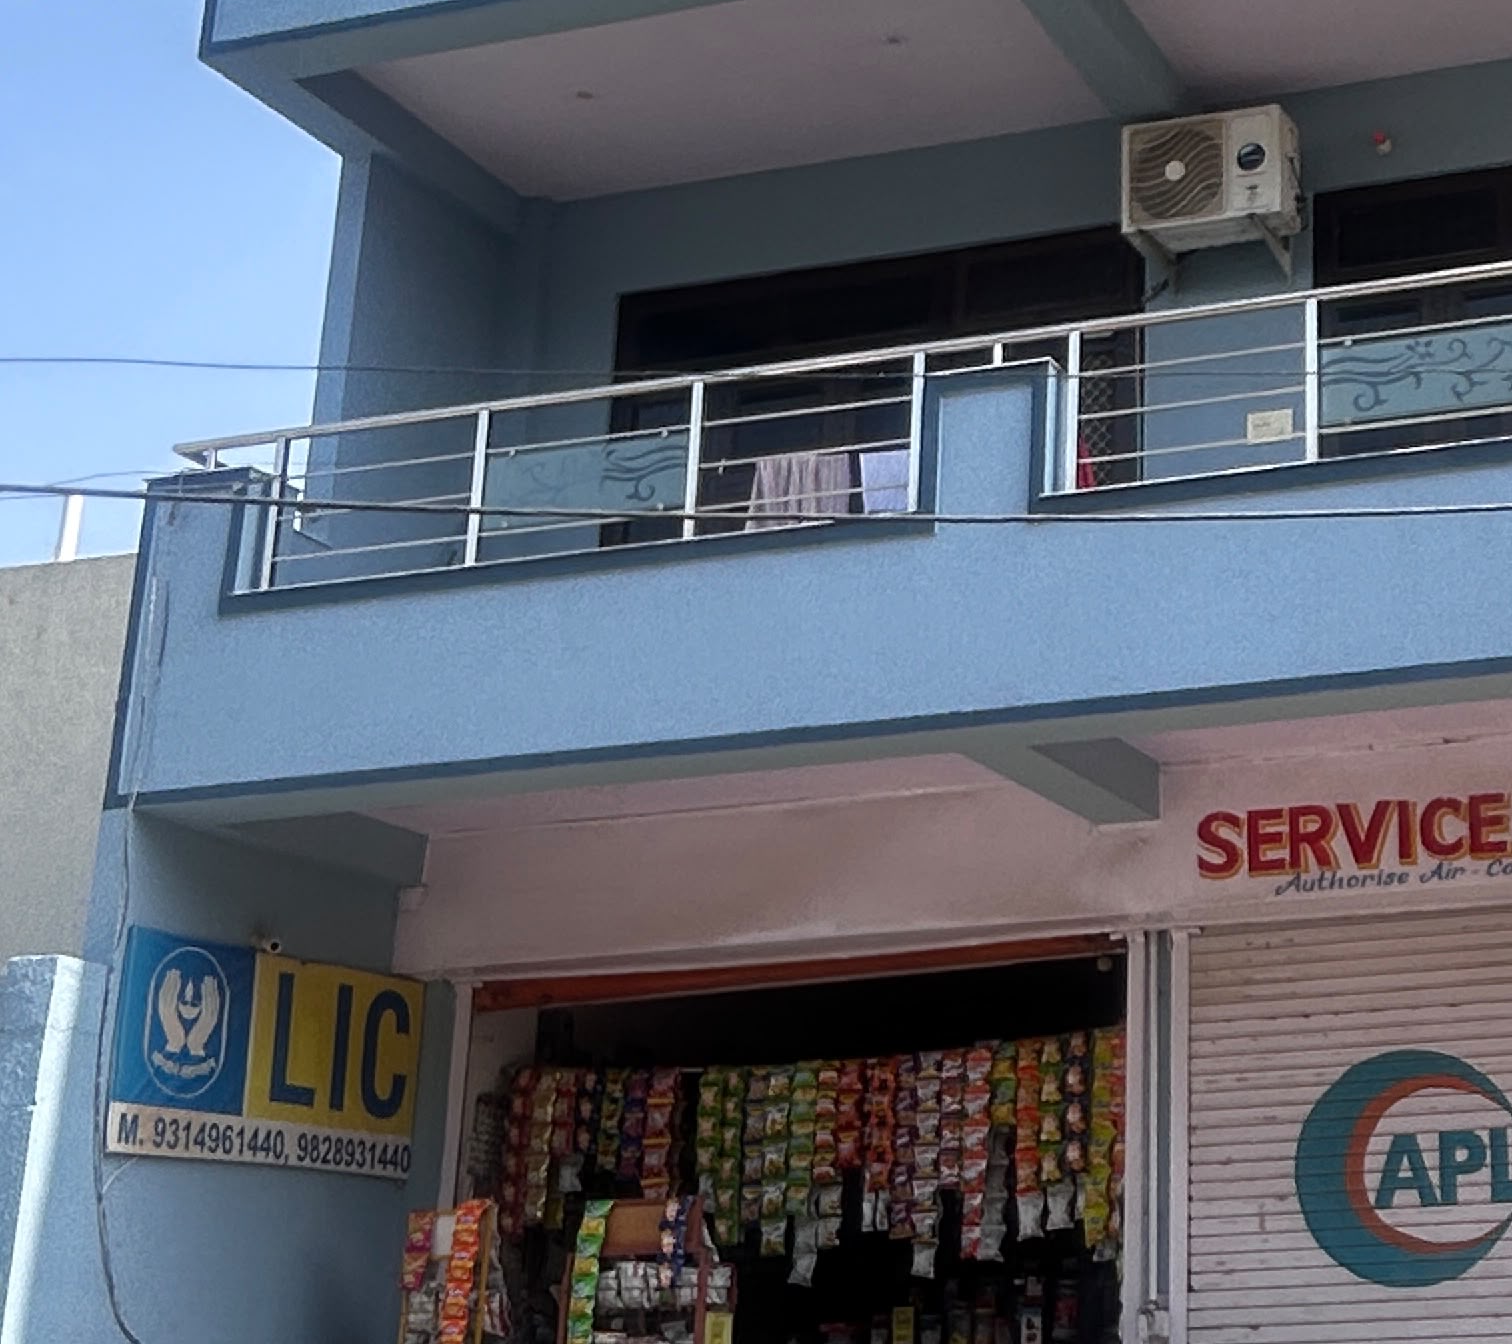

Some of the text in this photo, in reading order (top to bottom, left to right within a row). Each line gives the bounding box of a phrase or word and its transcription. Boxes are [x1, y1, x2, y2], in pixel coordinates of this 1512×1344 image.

[1274, 869, 1410, 896] Authorise
[269, 972, 411, 1120] LIC
[117, 1112, 412, 1174] M. 9314961440, 9828931440
